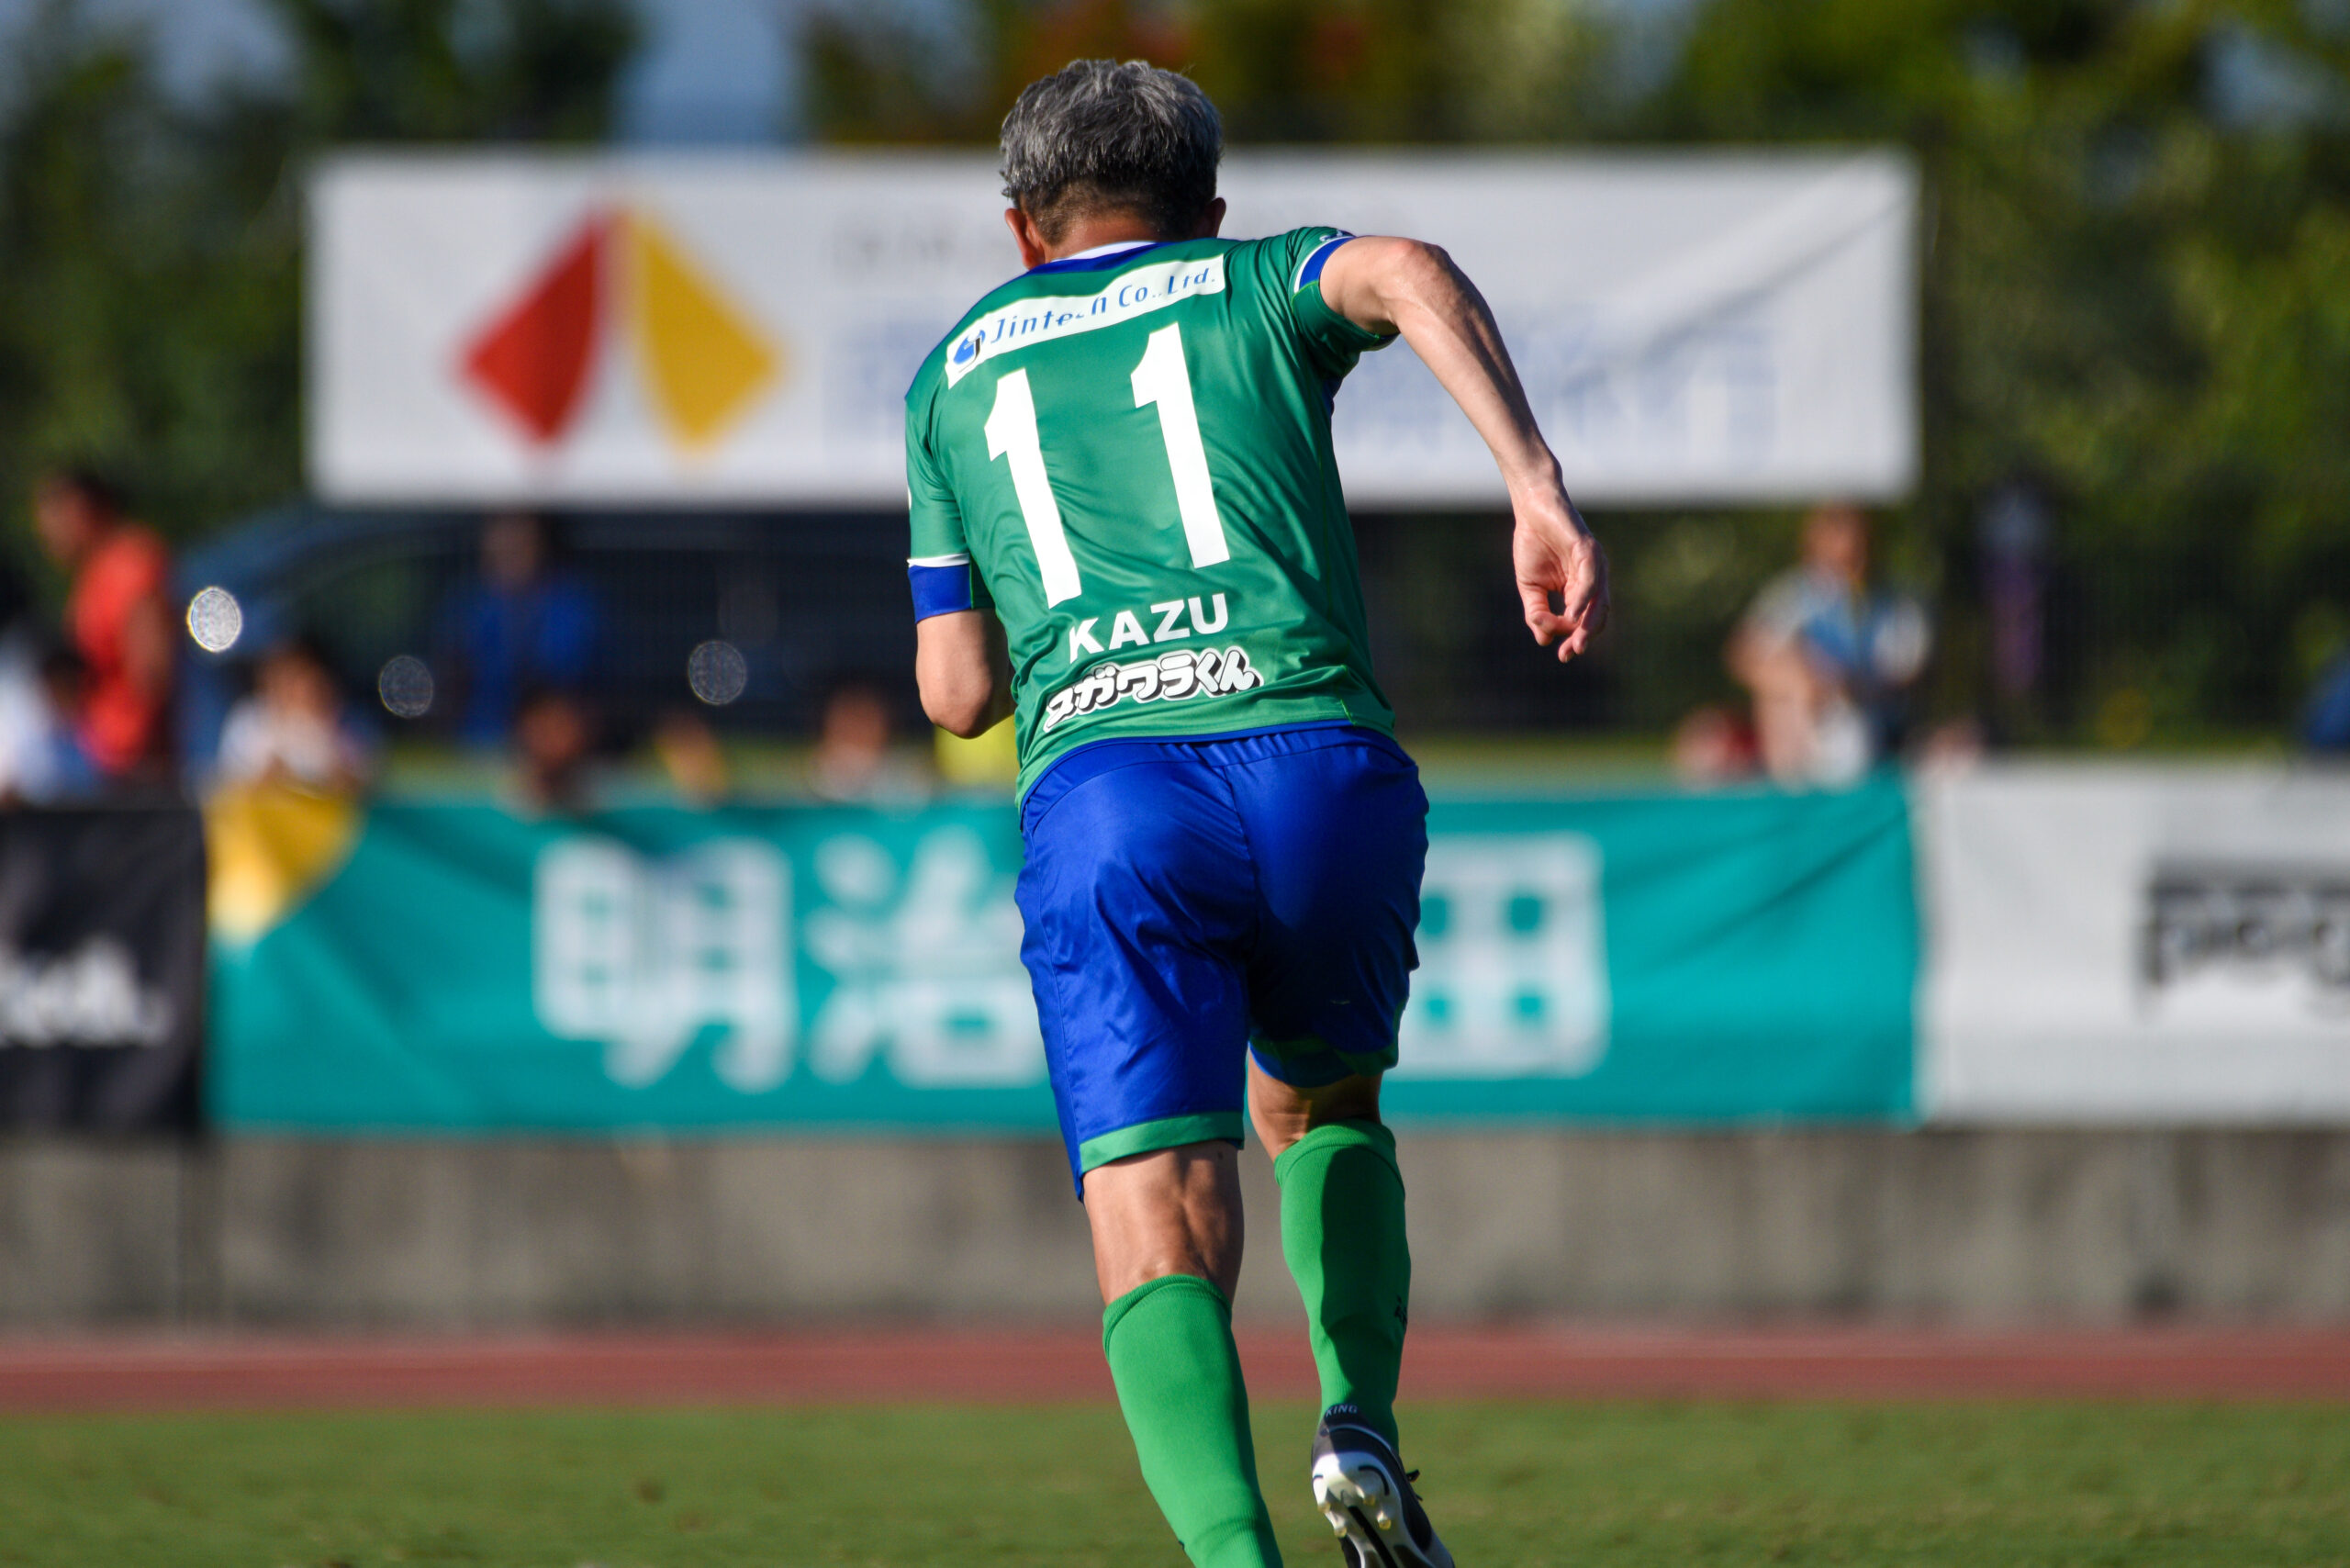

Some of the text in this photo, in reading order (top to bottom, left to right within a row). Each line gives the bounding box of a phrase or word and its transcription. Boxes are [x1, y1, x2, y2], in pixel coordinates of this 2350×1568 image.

[984, 321, 1230, 610] 11
[1069, 592, 1228, 665] KAZU
[1043, 645, 1265, 733] スガワラくん
